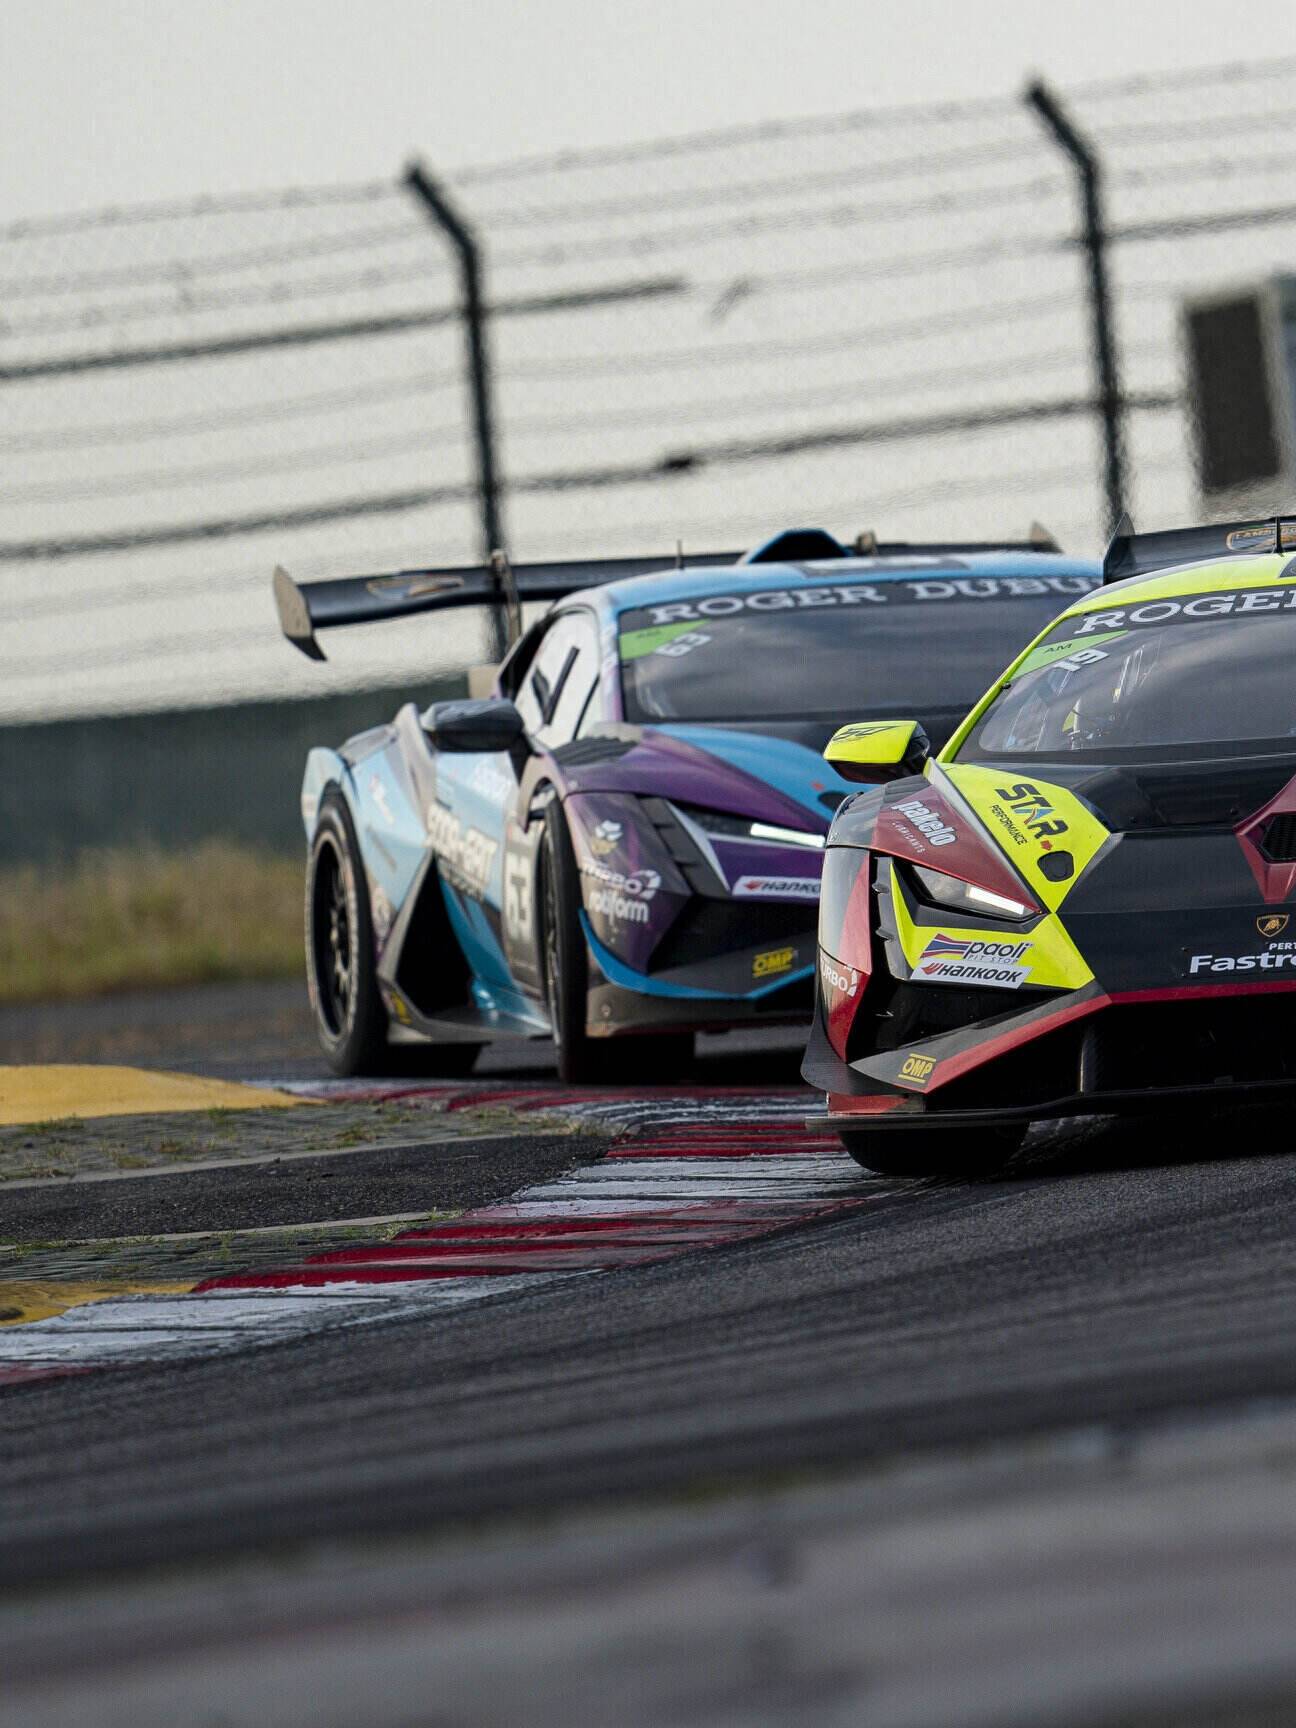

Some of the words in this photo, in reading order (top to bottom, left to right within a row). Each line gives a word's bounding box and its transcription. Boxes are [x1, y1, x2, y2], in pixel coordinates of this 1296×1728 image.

[650, 585, 888, 625] ROGER
[907, 577, 1103, 600] DUBU
[1053, 648, 1110, 672] 19
[891, 800, 957, 846] pakelo
[994, 783, 1069, 840] STAR
[963, 942, 1033, 960] paoli
[902, 1057, 933, 1079] OMP
